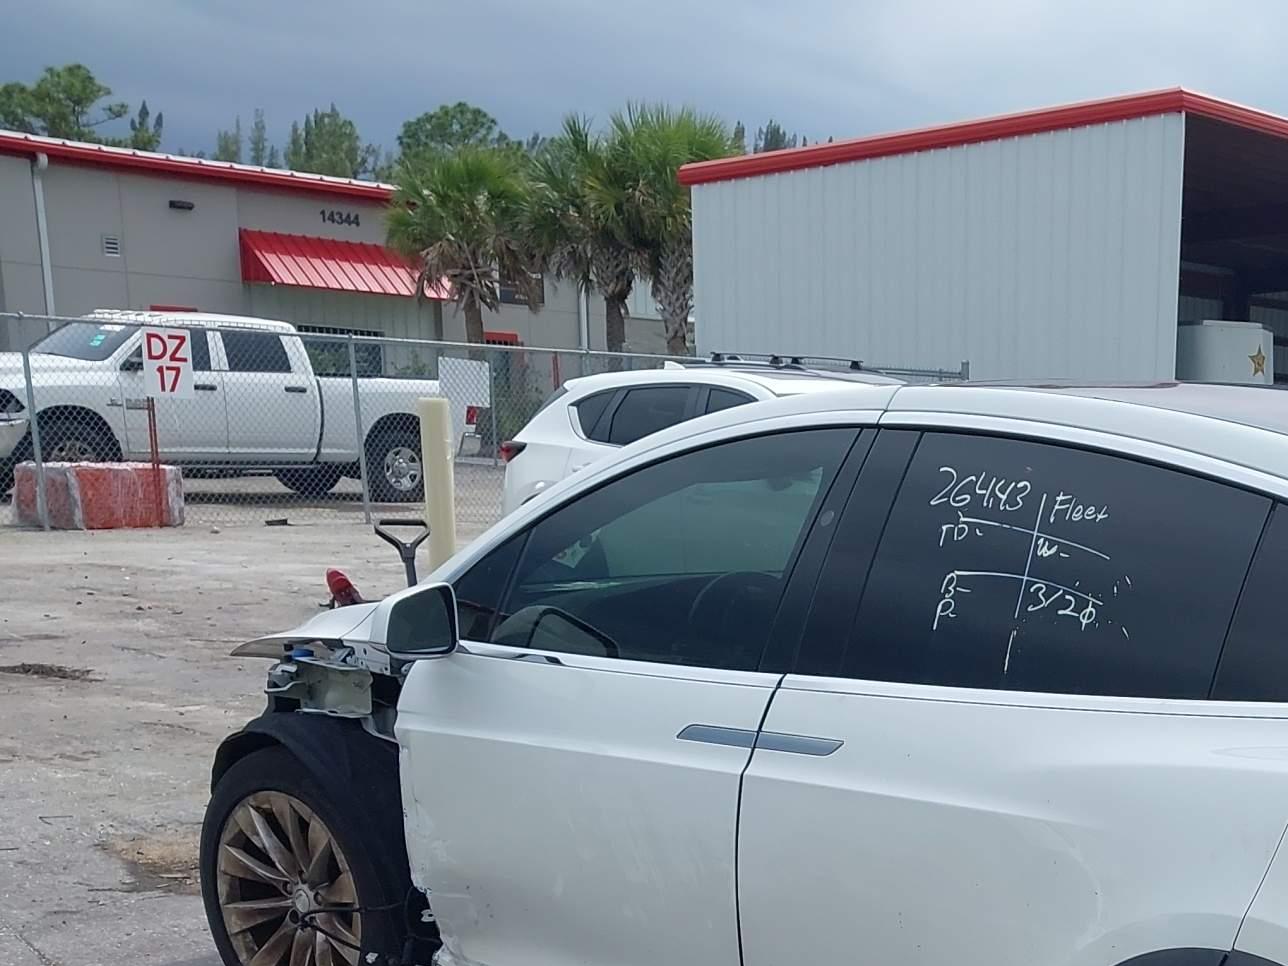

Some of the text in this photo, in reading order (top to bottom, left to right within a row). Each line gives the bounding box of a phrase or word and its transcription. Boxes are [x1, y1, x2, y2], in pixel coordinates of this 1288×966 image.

[320, 209, 360, 227] 14344
[145, 332, 188, 363] DZ
[156, 365, 182, 393] 17
